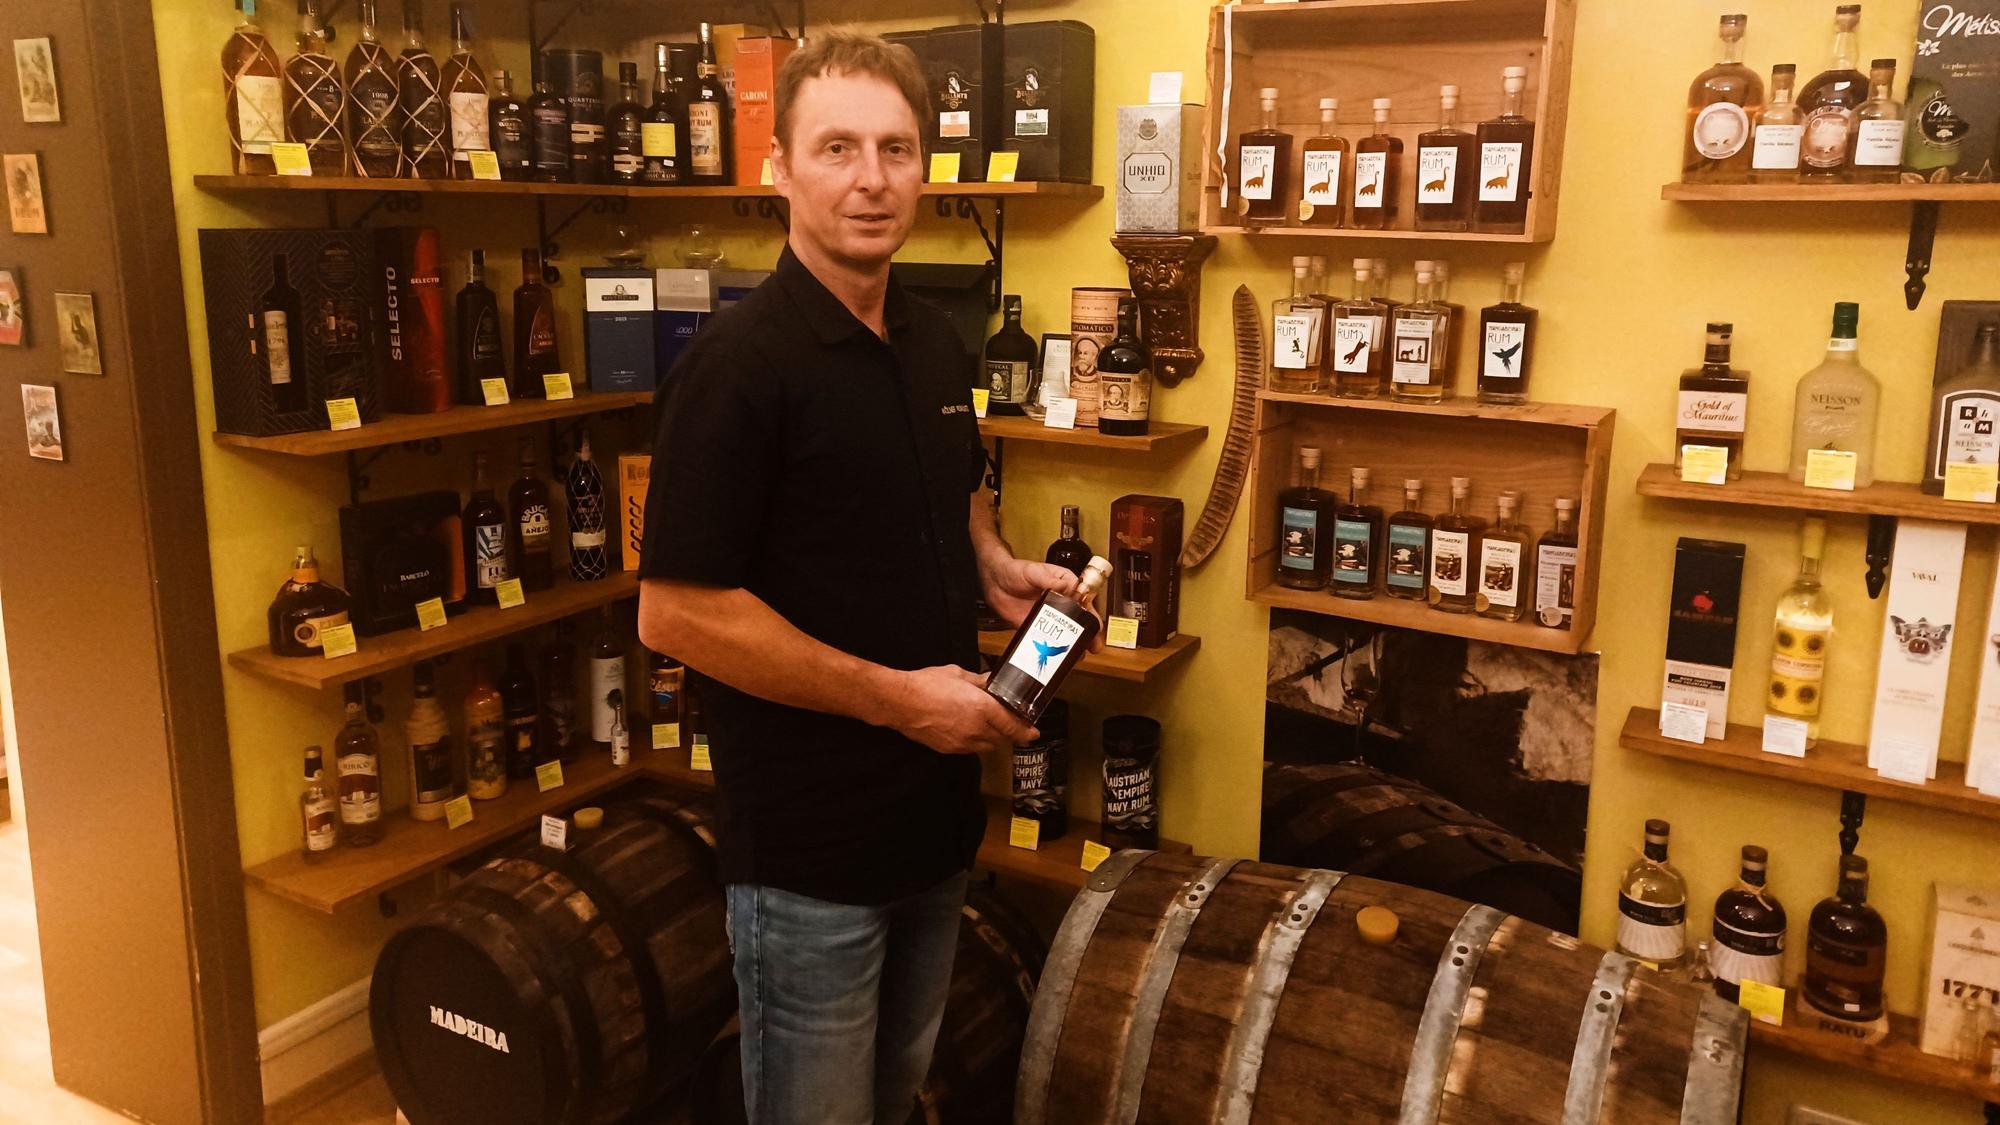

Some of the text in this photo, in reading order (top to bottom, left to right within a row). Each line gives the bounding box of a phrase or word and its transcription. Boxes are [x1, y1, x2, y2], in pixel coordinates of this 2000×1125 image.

[740, 90, 768, 100] CARONI
[1243, 156, 1262, 166] RUM
[1306, 161, 1328, 171] RUM
[1422, 158, 1443, 169] RUM
[1483, 154, 1507, 166] RUM
[1129, 165, 1165, 175] UNHIQ
[1358, 163, 1375, 173] RUM
[410, 276, 440, 285] SELECTO
[386, 266, 402, 361] SELECTO
[1276, 326, 1297, 337] RUM
[1337, 329, 1358, 340] RUM
[1487, 332, 1511, 344] RUM
[1690, 399, 1736, 412] Gold of
[1811, 394, 1861, 406] NEISSON
[1683, 410, 1740, 422] Mauritius
[1034, 616, 1064, 640] RUM
[1043, 609, 1079, 636] MANGABEIRAS
[1016, 767, 1043, 778] EMPIRE
[1108, 768, 1151, 789] AUSTRIAN
[1020, 779, 1043, 790] NAVY
[1117, 783, 1151, 800] EMPIRE
[1107, 795, 1151, 814] NAVY RUM
[429, 1004, 510, 1054] MADEIRA
